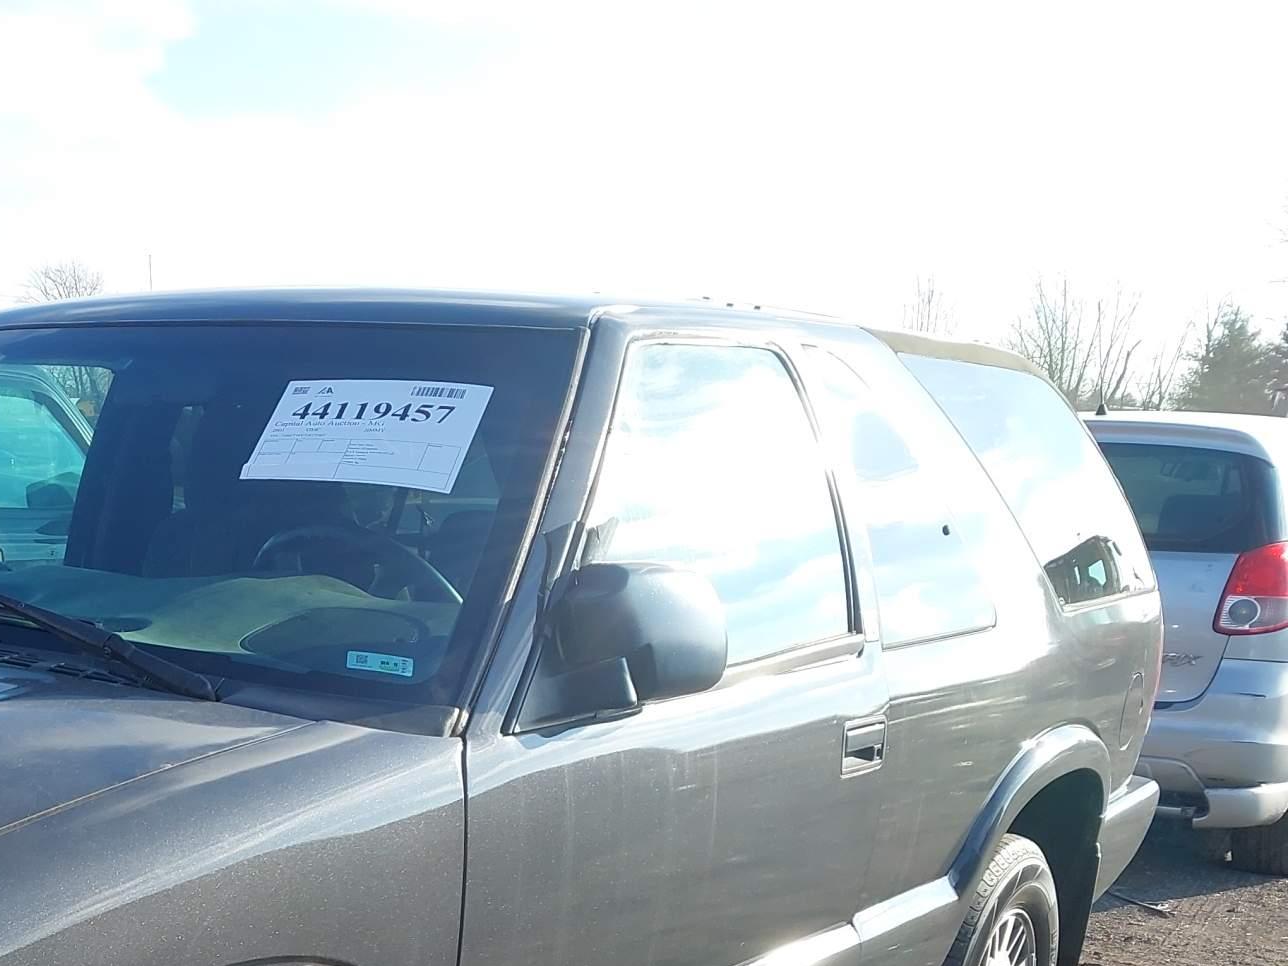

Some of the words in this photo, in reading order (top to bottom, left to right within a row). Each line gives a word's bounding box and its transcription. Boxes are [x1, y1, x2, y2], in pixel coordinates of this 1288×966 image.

[292, 402, 456, 424] 44119457
[274, 420, 304, 428] Capital
[327, 420, 360, 428] Auction
